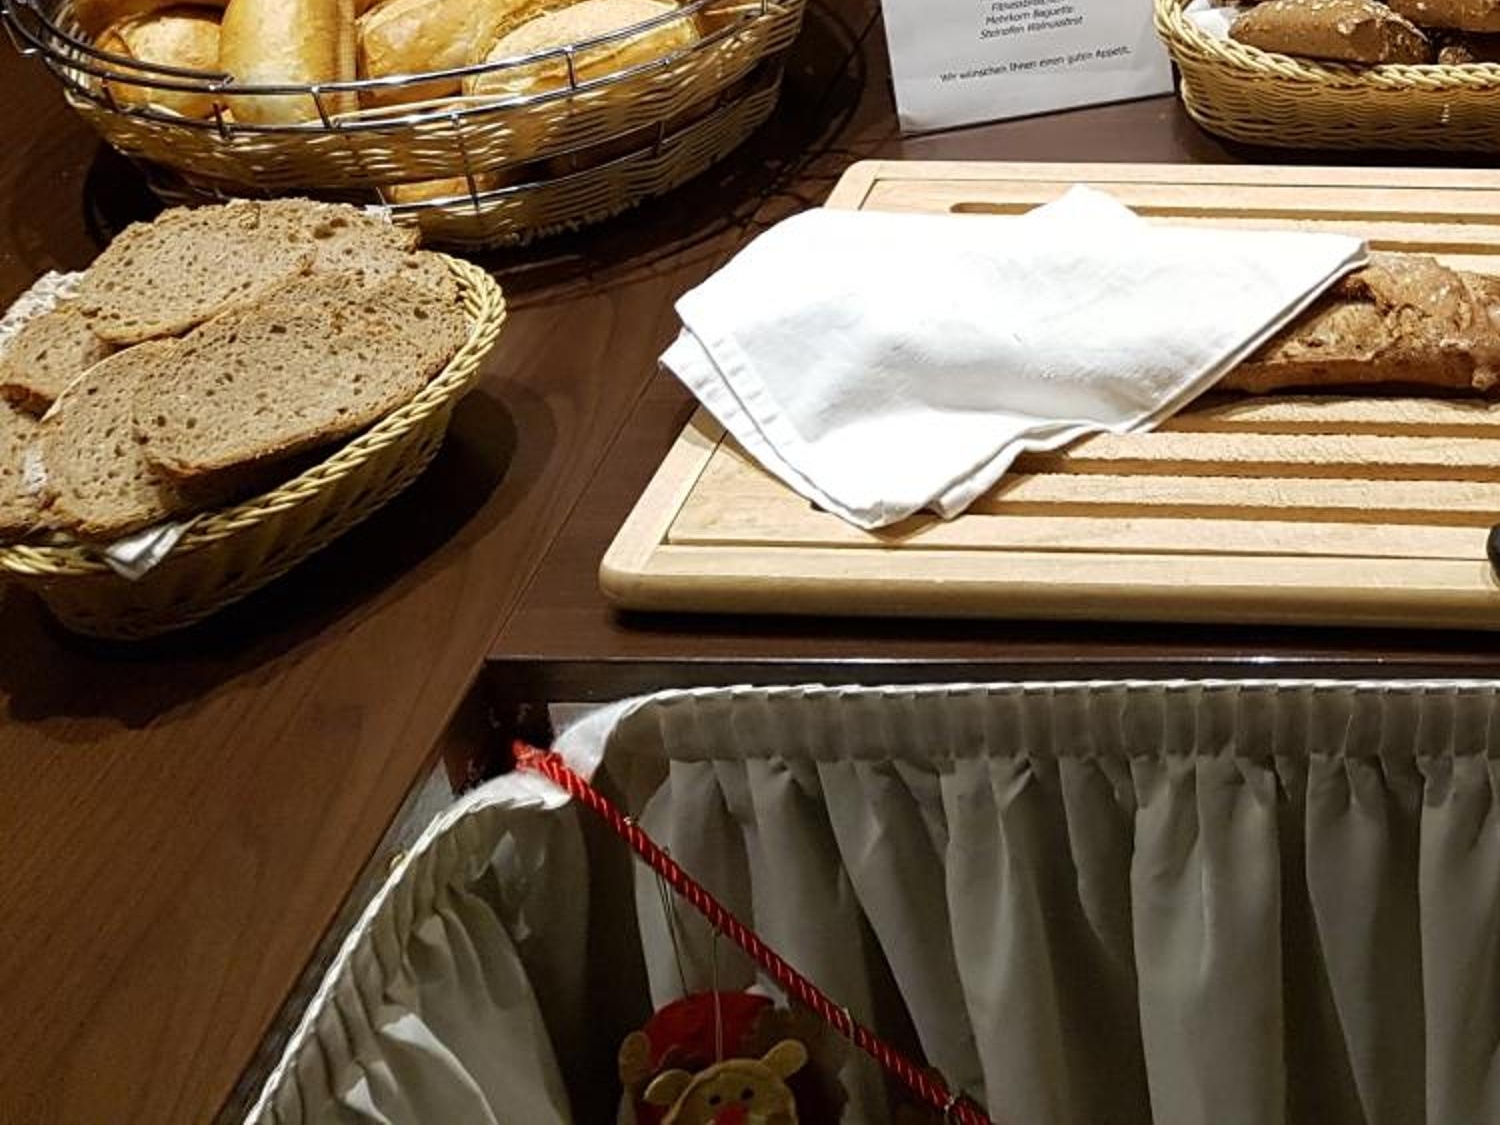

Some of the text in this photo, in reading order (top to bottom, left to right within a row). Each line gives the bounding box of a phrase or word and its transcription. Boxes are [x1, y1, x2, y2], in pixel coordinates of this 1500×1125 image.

[940, 71, 957, 82] Wir
[958, 64, 1007, 80] wünschen
[1009, 59, 1037, 71] Ihnen
[1039, 56, 1065, 67] einen
[1067, 51, 1093, 64] guten
